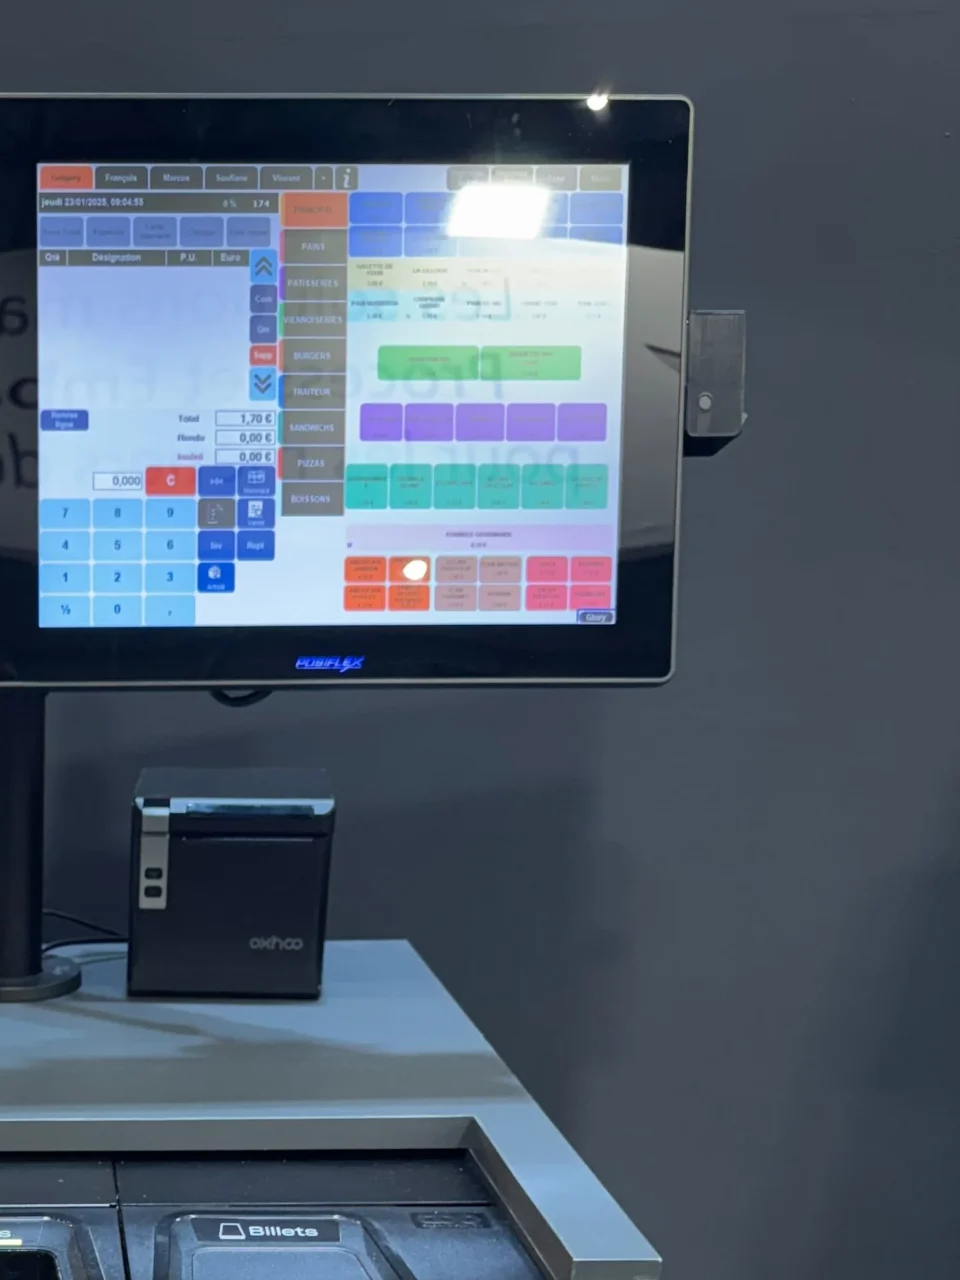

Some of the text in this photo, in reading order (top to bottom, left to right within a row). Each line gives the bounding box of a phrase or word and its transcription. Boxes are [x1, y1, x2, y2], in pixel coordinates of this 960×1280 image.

[105, 173, 137, 183] François
[272, 173, 300, 182] Vincent
[41, 198, 63, 208] jeudi
[302, 242, 325, 251] PAINS
[221, 253, 241, 262] Euro
[287, 279, 338, 288] PATISSERIES
[293, 352, 331, 360] BURGERS
[293, 388, 331, 396] TRAITEUR
[179, 414, 272, 425] Total 1,70 €
[239, 433, 262, 445] 0,00
[264, 433, 272, 443] €
[239, 452, 262, 464] 0,00
[264, 452, 272, 462] €
[297, 459, 325, 467] PIZZAS
[112, 475, 141, 487] 0,000
[291, 495, 330, 503] BOISSONS
[585, 613, 607, 623] Glory
[295, 656, 365, 673] POSIFLEX
[249, 935, 304, 951] oxhoo
[248, 1226, 318, 1237] Billets
